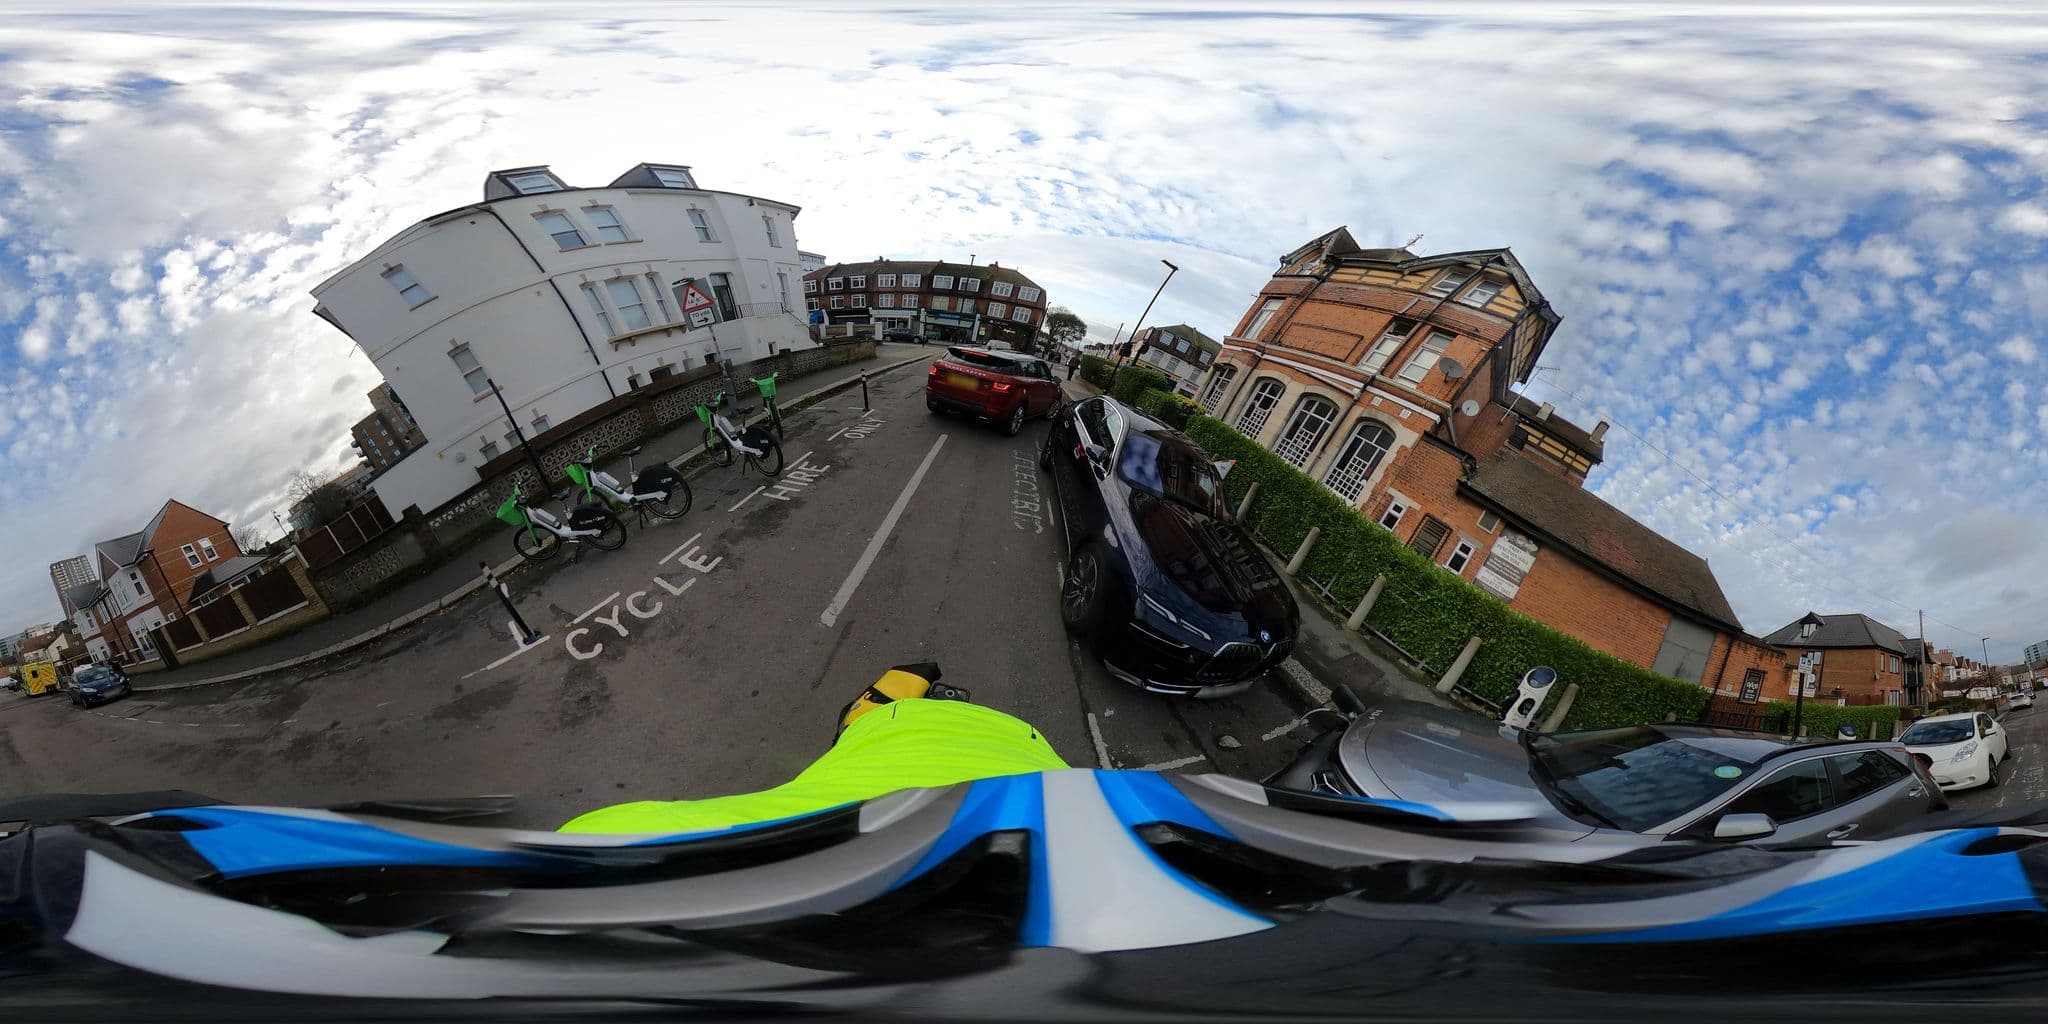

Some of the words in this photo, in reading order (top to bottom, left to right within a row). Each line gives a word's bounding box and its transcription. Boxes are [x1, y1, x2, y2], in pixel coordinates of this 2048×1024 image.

[565, 545, 724, 660] CYCLE
[762, 461, 831, 501] HIRE
[844, 417, 886, 439] ONLY
